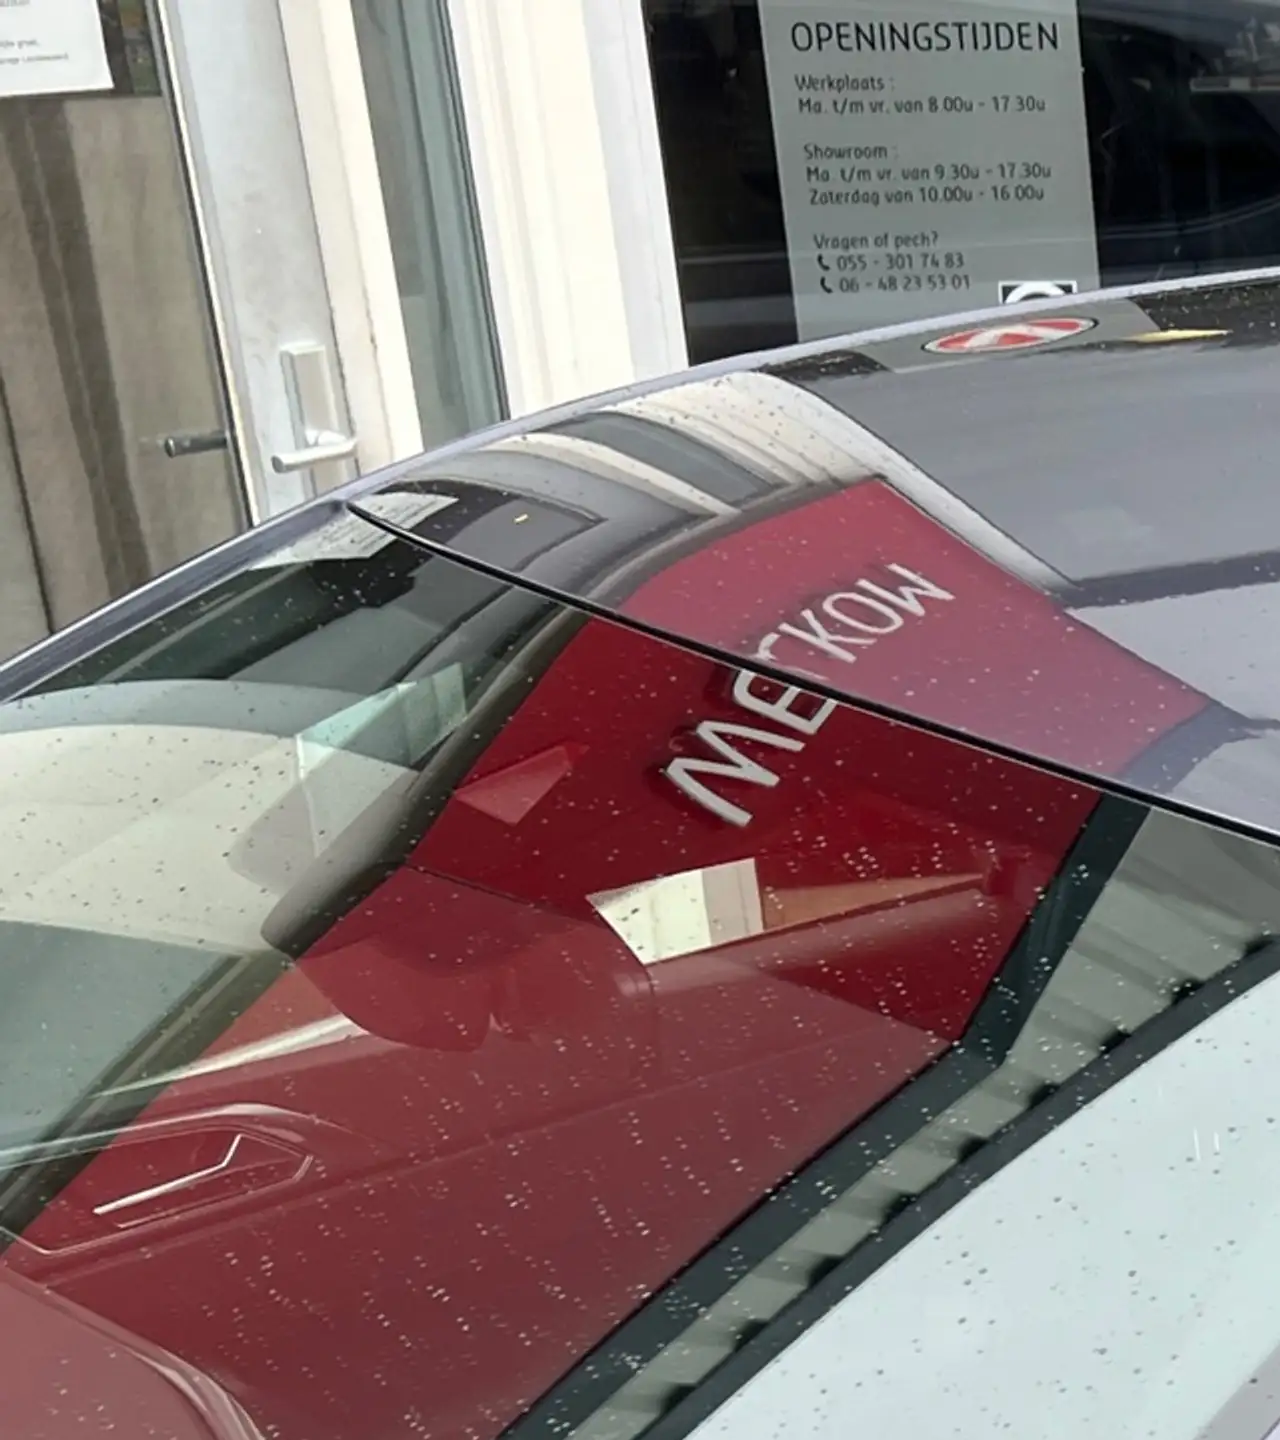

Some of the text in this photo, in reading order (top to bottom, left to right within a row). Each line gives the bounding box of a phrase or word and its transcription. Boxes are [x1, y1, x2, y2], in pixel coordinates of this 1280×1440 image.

[791, 21, 1058, 52] OPENINGSTIJDEN
[794, 73, 885, 94] Werkplaats
[833, 97, 864, 115] t/m
[895, 99, 923, 114] van
[803, 143, 888, 160] Showroom
[840, 165, 871, 183] t/m
[902, 167, 930, 181] van
[809, 187, 880, 208] Zaterdag
[885, 189, 914, 204] van
[813, 230, 939, 252] Vragen of pech?
[836, 254, 867, 273] 055
[885, 253, 914, 270] 301
[951, 274, 970, 291] 01
